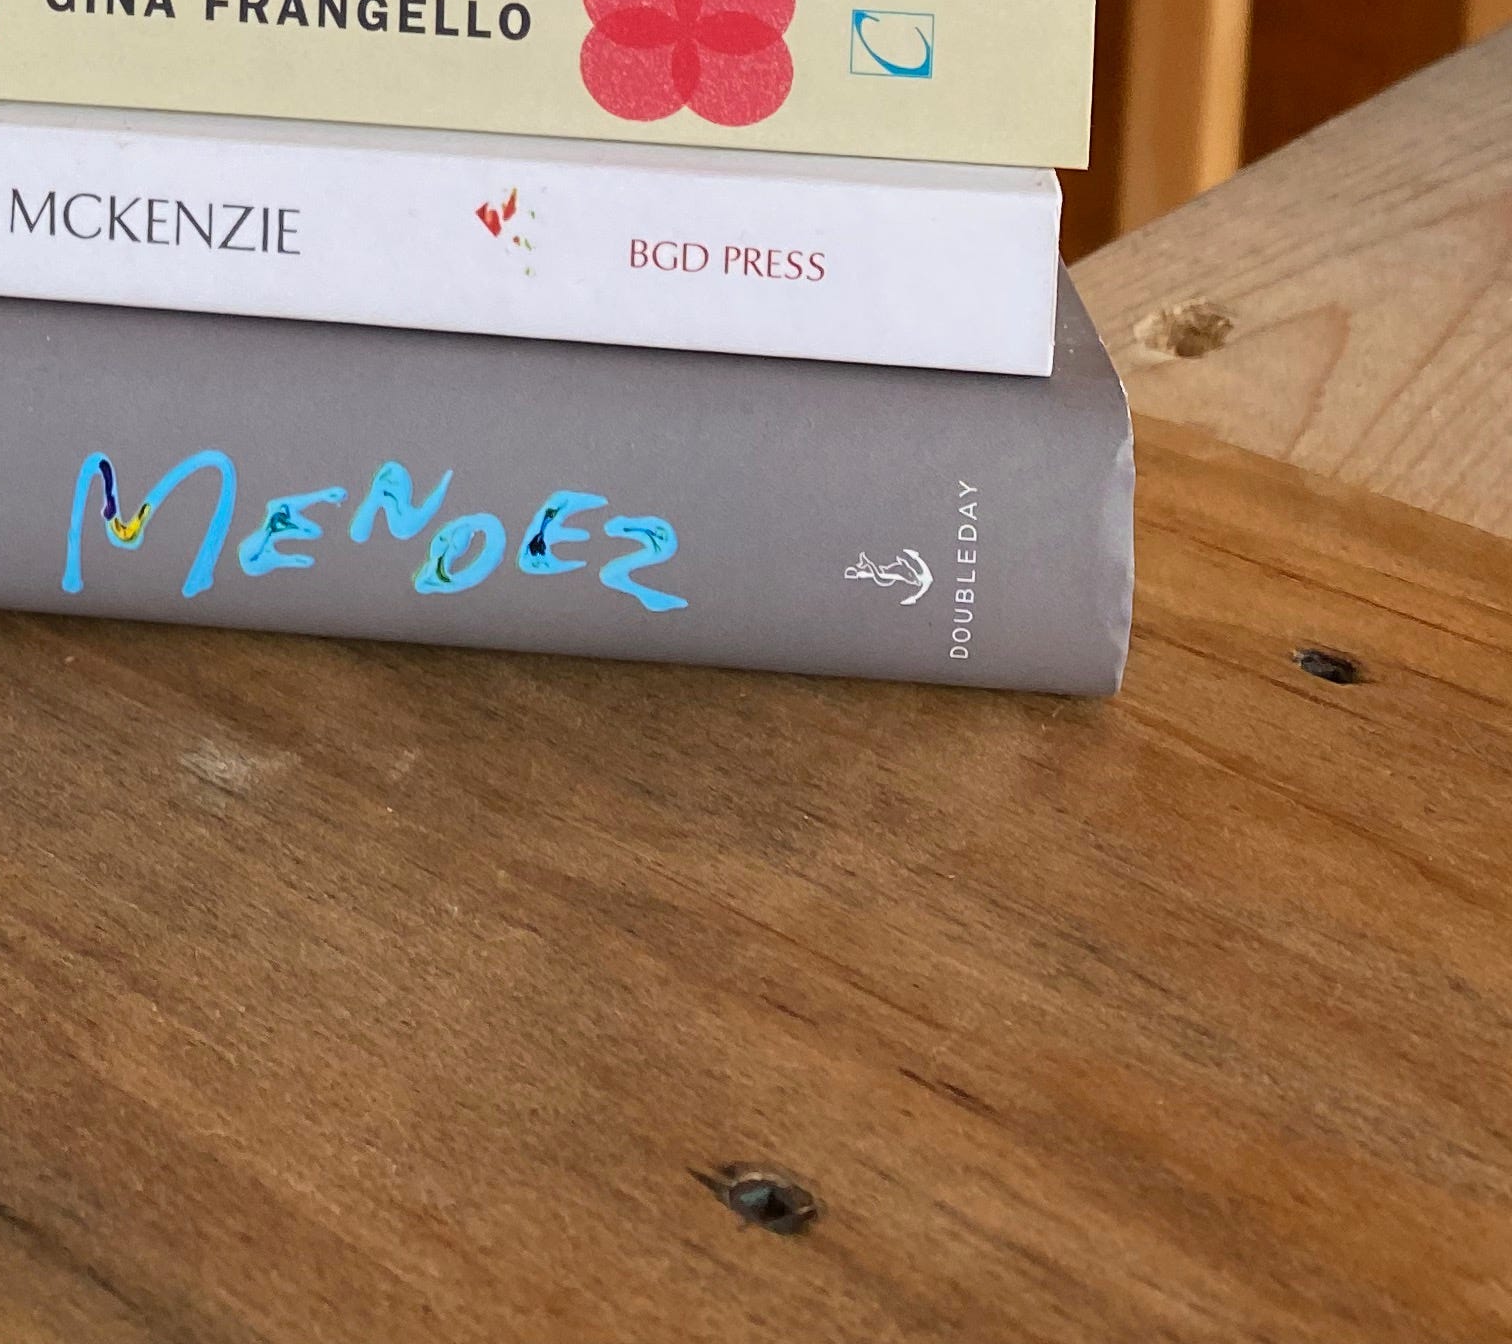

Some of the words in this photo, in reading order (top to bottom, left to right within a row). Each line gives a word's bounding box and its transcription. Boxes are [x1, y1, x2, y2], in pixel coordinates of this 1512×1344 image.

[9, 187, 302, 257] MCKENZIE
[629, 237, 709, 275] BGD
[723, 244, 826, 282] PRESS
[950, 480, 978, 659] DOUBLEDAY
